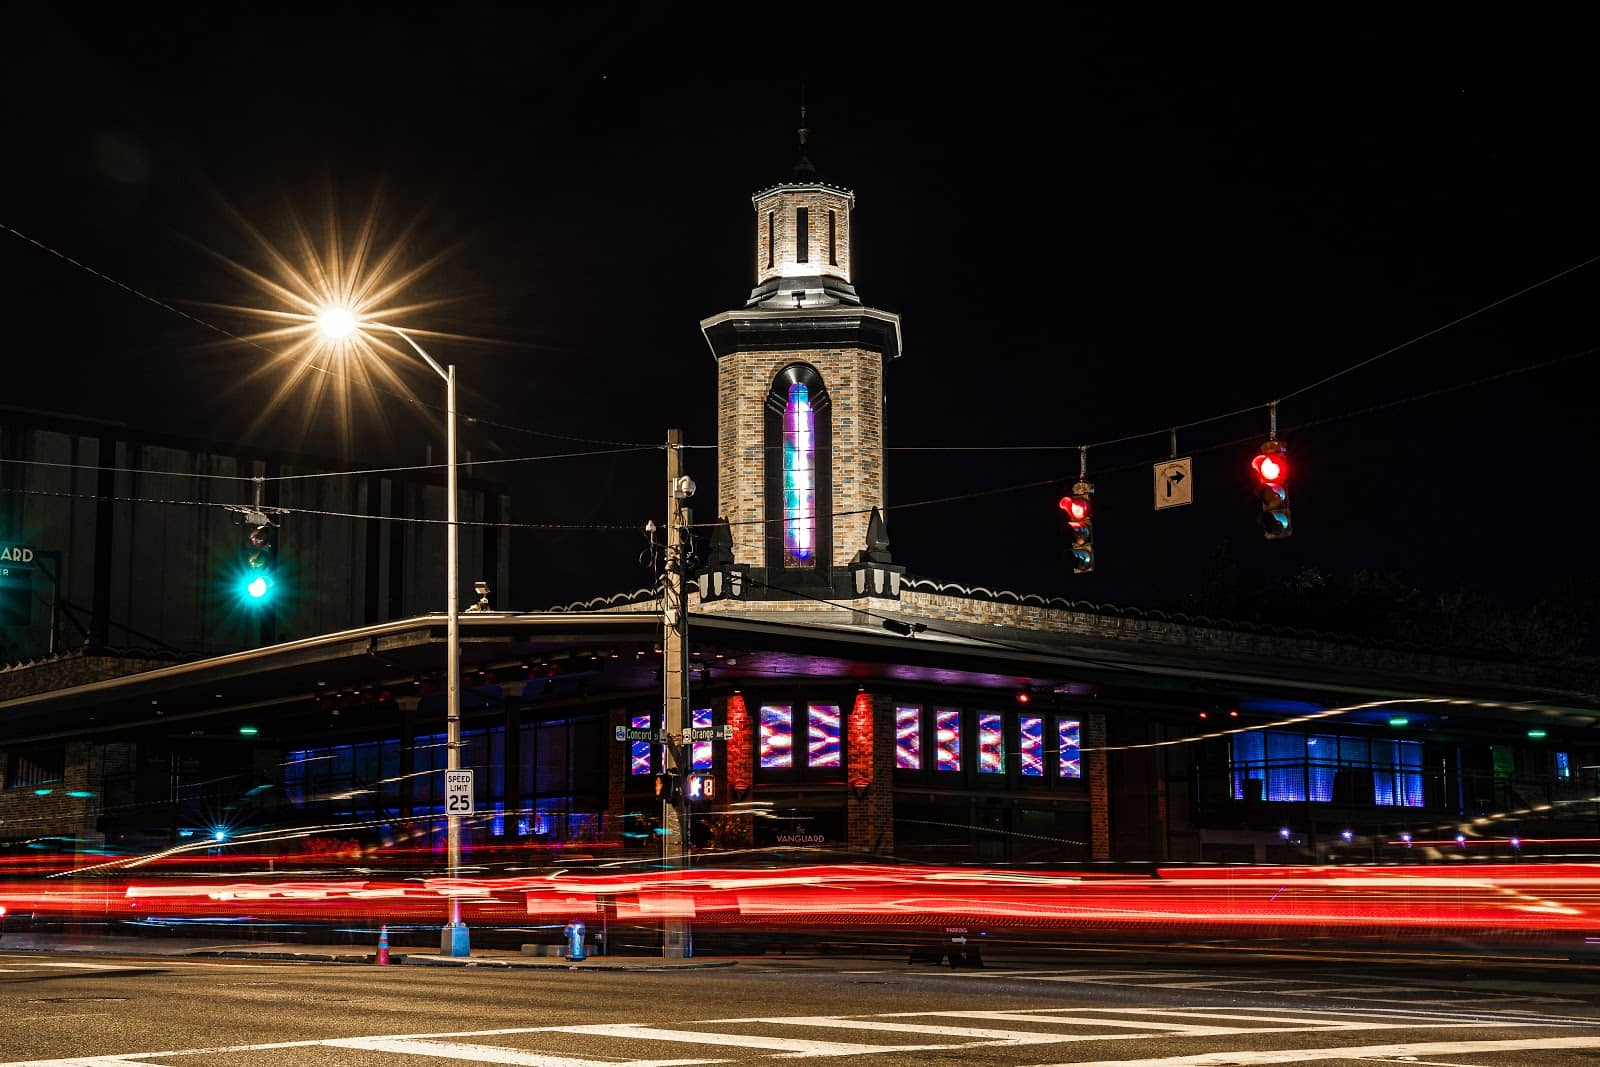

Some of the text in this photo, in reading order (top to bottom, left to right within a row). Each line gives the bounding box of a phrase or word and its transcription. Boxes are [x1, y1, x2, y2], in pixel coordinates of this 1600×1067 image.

[626, 728, 651, 740] Concord
[692, 728, 713, 741] Orange
[448, 775, 471, 783] SPEED
[450, 784, 469, 792] LIMIT
[449, 794, 470, 811] 25
[776, 834, 825, 843] VANGUARD
